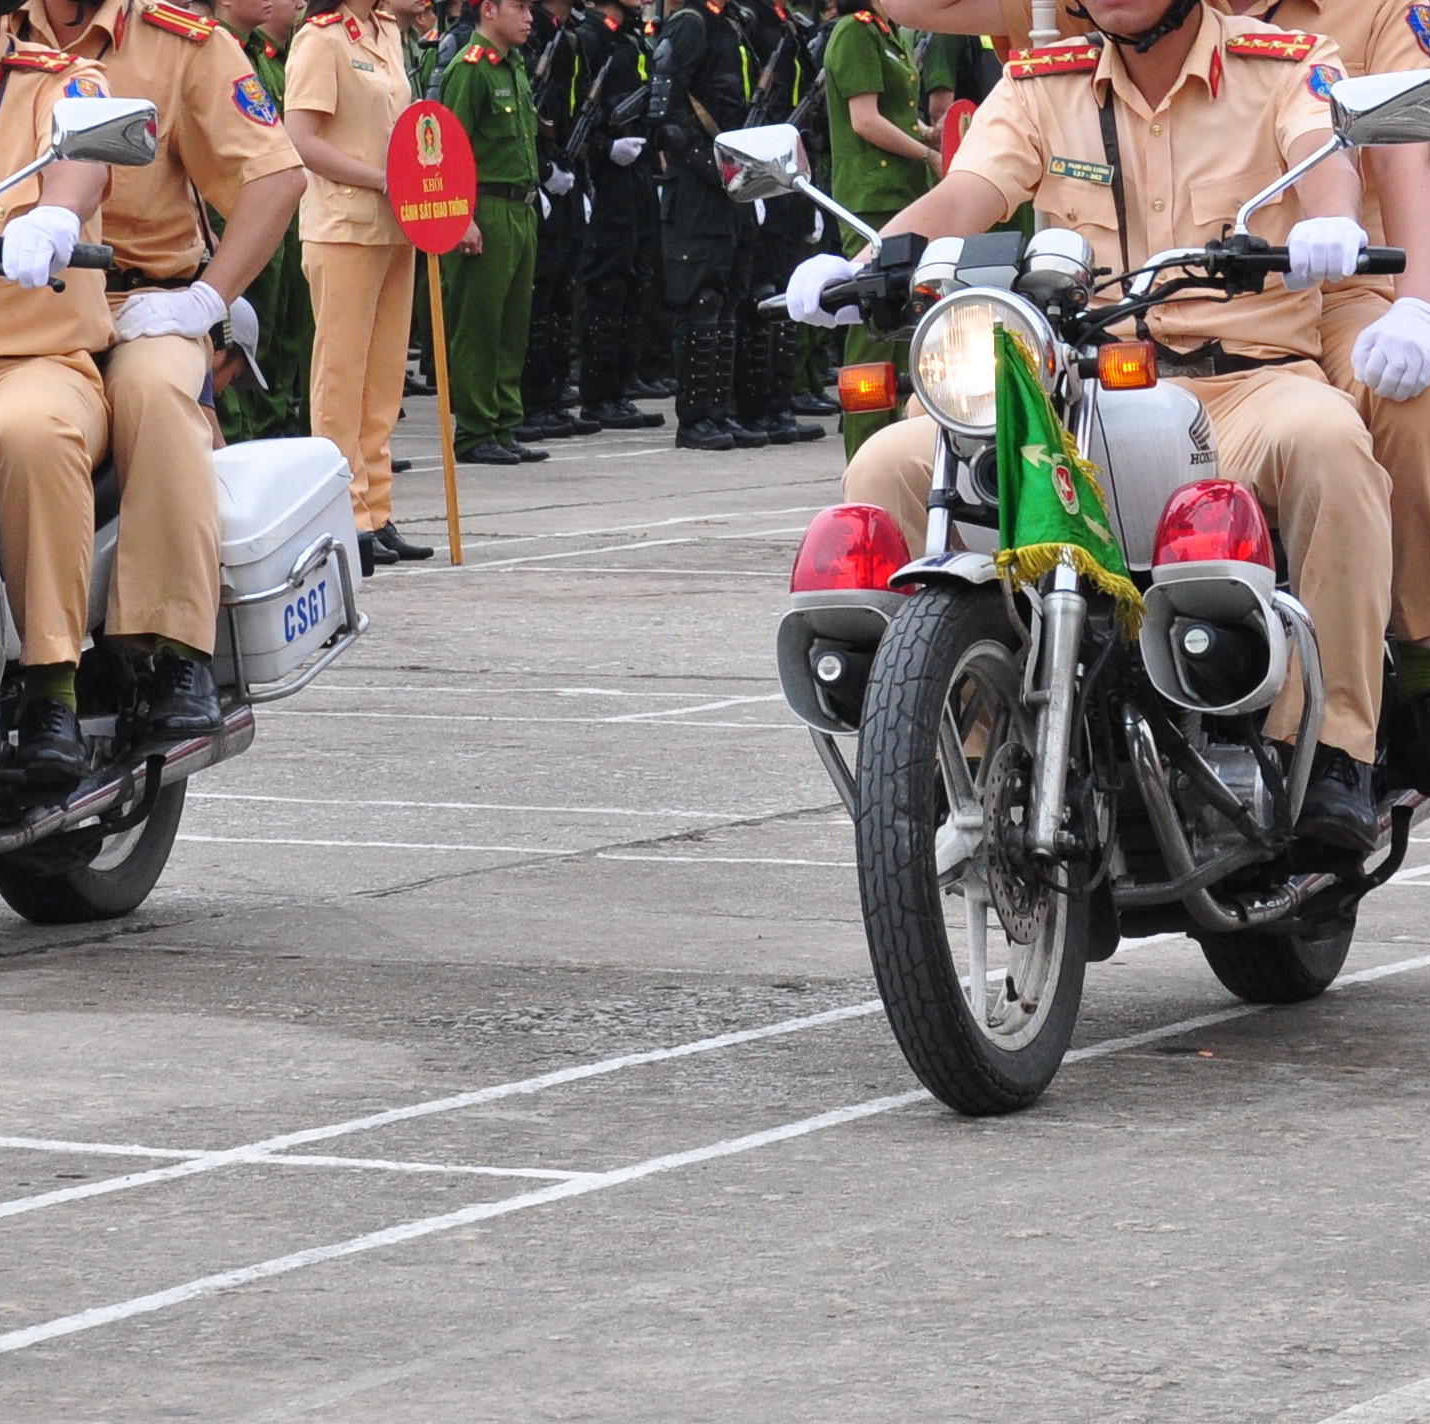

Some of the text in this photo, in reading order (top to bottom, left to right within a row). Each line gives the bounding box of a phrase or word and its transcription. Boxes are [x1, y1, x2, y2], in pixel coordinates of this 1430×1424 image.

[422, 171, 443, 193] KHỐI
[400, 199, 419, 222] CẢNH
[418, 199, 432, 220] SÁT
[433, 201, 448, 219] GIAO
[284, 580, 326, 643] CSGT
